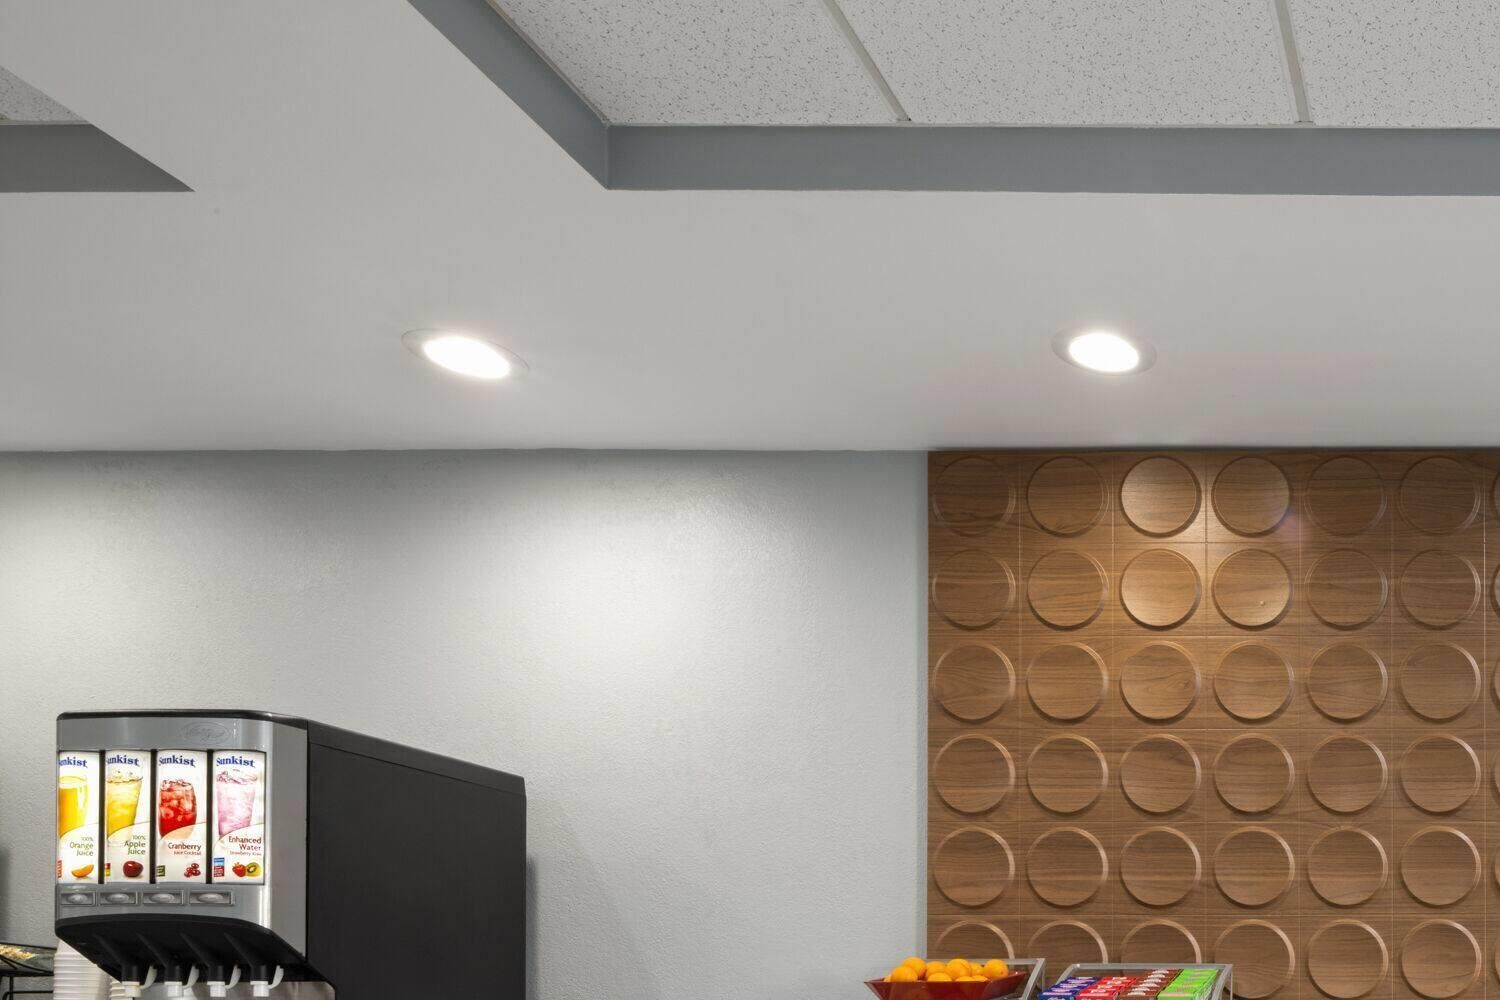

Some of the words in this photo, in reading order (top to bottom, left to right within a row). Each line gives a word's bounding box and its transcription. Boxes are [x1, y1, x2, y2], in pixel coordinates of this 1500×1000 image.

[58, 757, 88, 768] unkist
[107, 755, 140, 767] unkist
[216, 755, 256, 768] Sunkist
[124, 840, 146, 849] Apple
[228, 836, 262, 844] Enhanced
[69, 842, 94, 850] Orange
[168, 842, 201, 852] Cranberry
[239, 843, 261, 851] Water
[77, 849, 94, 857] Juice
